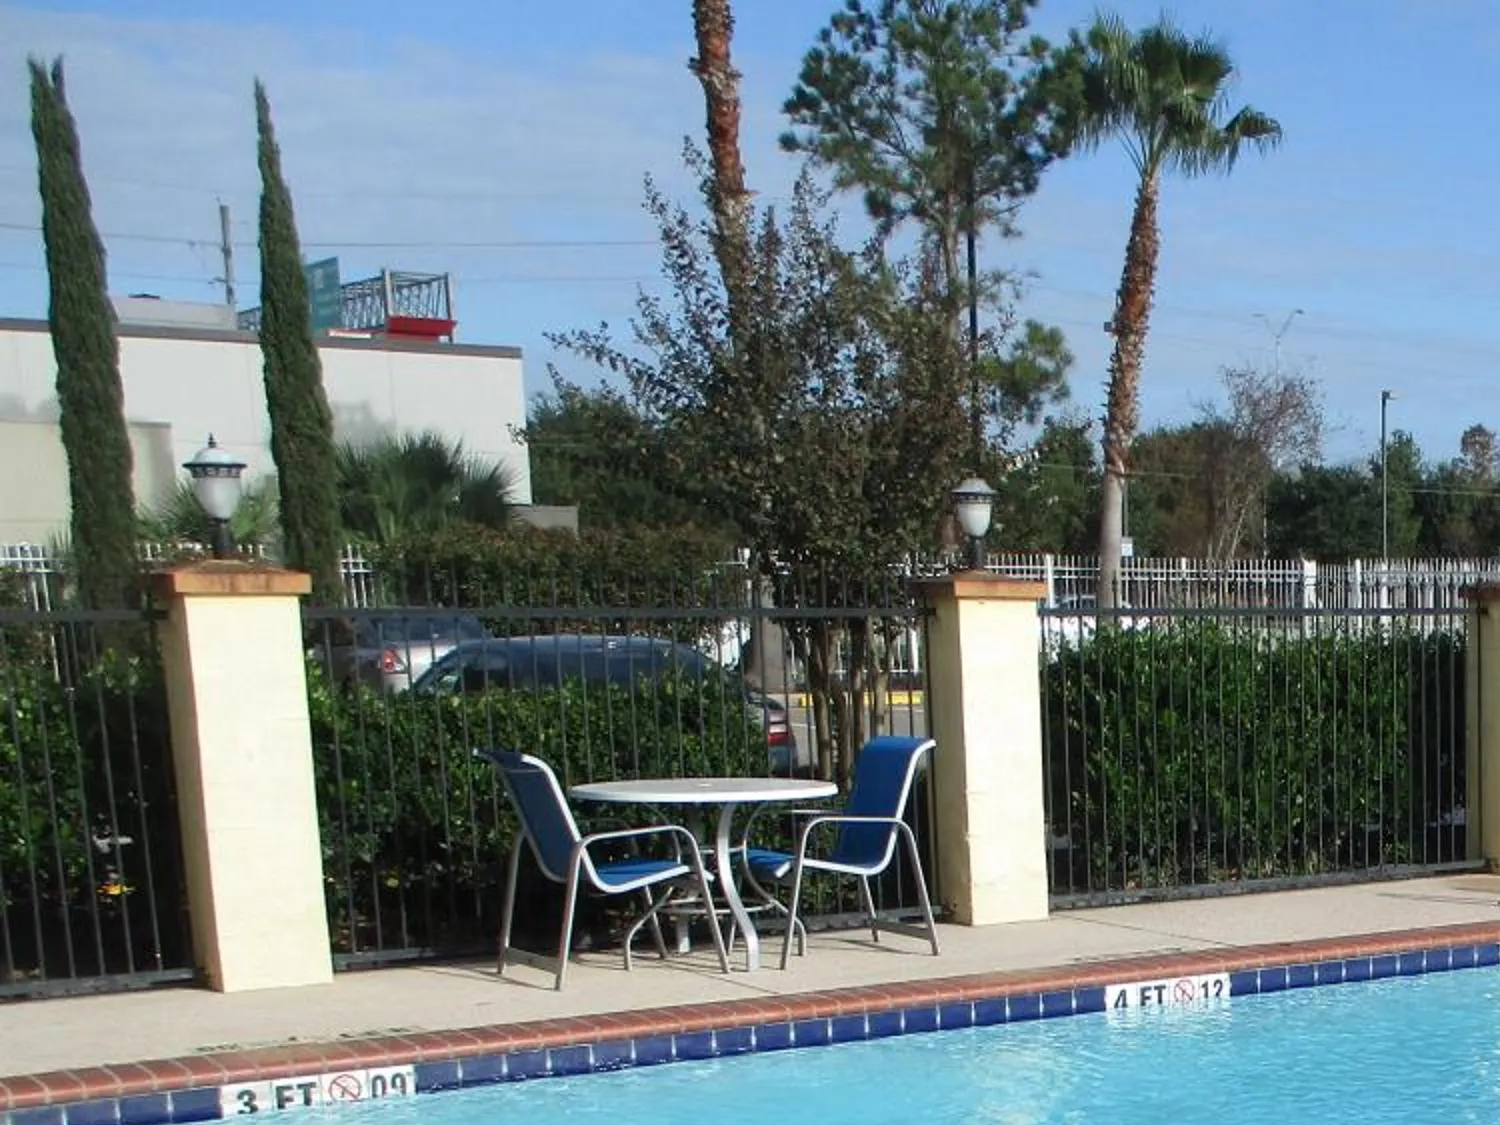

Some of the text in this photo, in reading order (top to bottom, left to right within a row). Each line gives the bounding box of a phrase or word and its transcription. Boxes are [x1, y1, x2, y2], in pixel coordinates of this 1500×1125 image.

[1139, 984, 1167, 1007] FT
[237, 1089, 259, 1115] 3
[275, 1081, 318, 1110] FT
